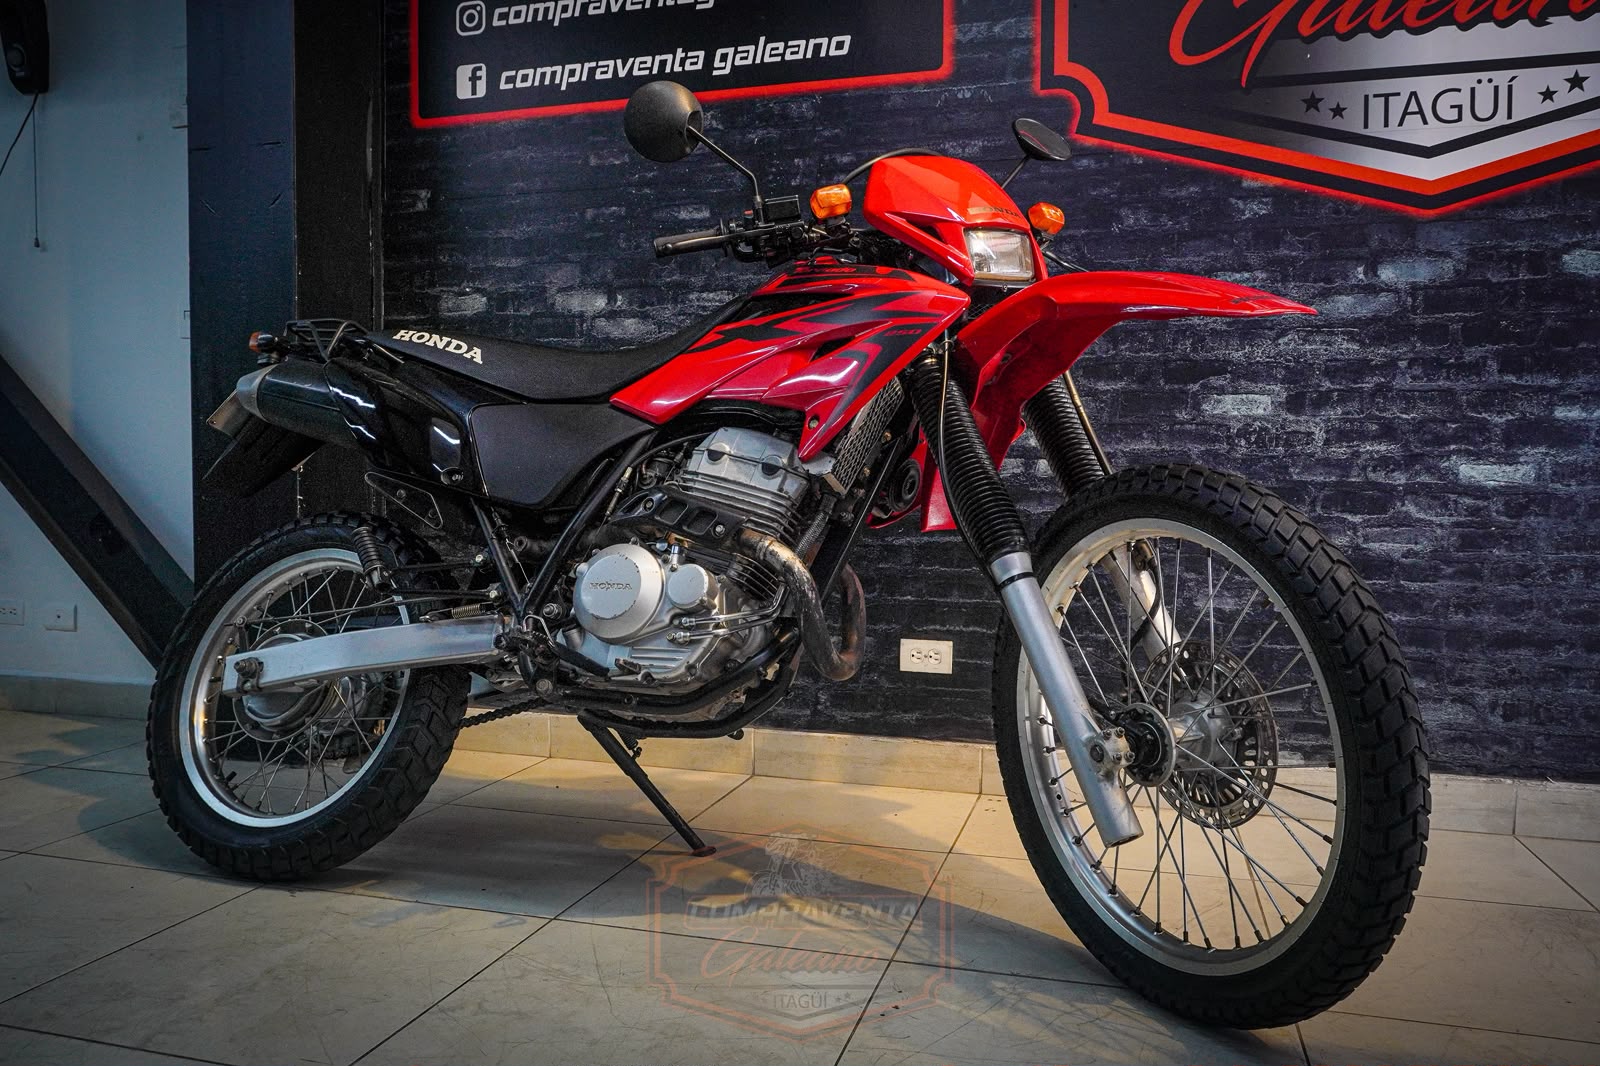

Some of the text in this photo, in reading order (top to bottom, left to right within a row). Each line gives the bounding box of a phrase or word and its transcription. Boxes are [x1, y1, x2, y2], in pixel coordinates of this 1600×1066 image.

[492, 0, 714, 26] comprave
[499, 48, 705, 90] compraventa
[713, 35, 851, 75] galeano
[1363, 76, 1518, 129] ITAGÜÍ
[972, 206, 1021, 218] ONDA
[393, 329, 483, 364] HONDA
[589, 581, 633, 591] HONDA
